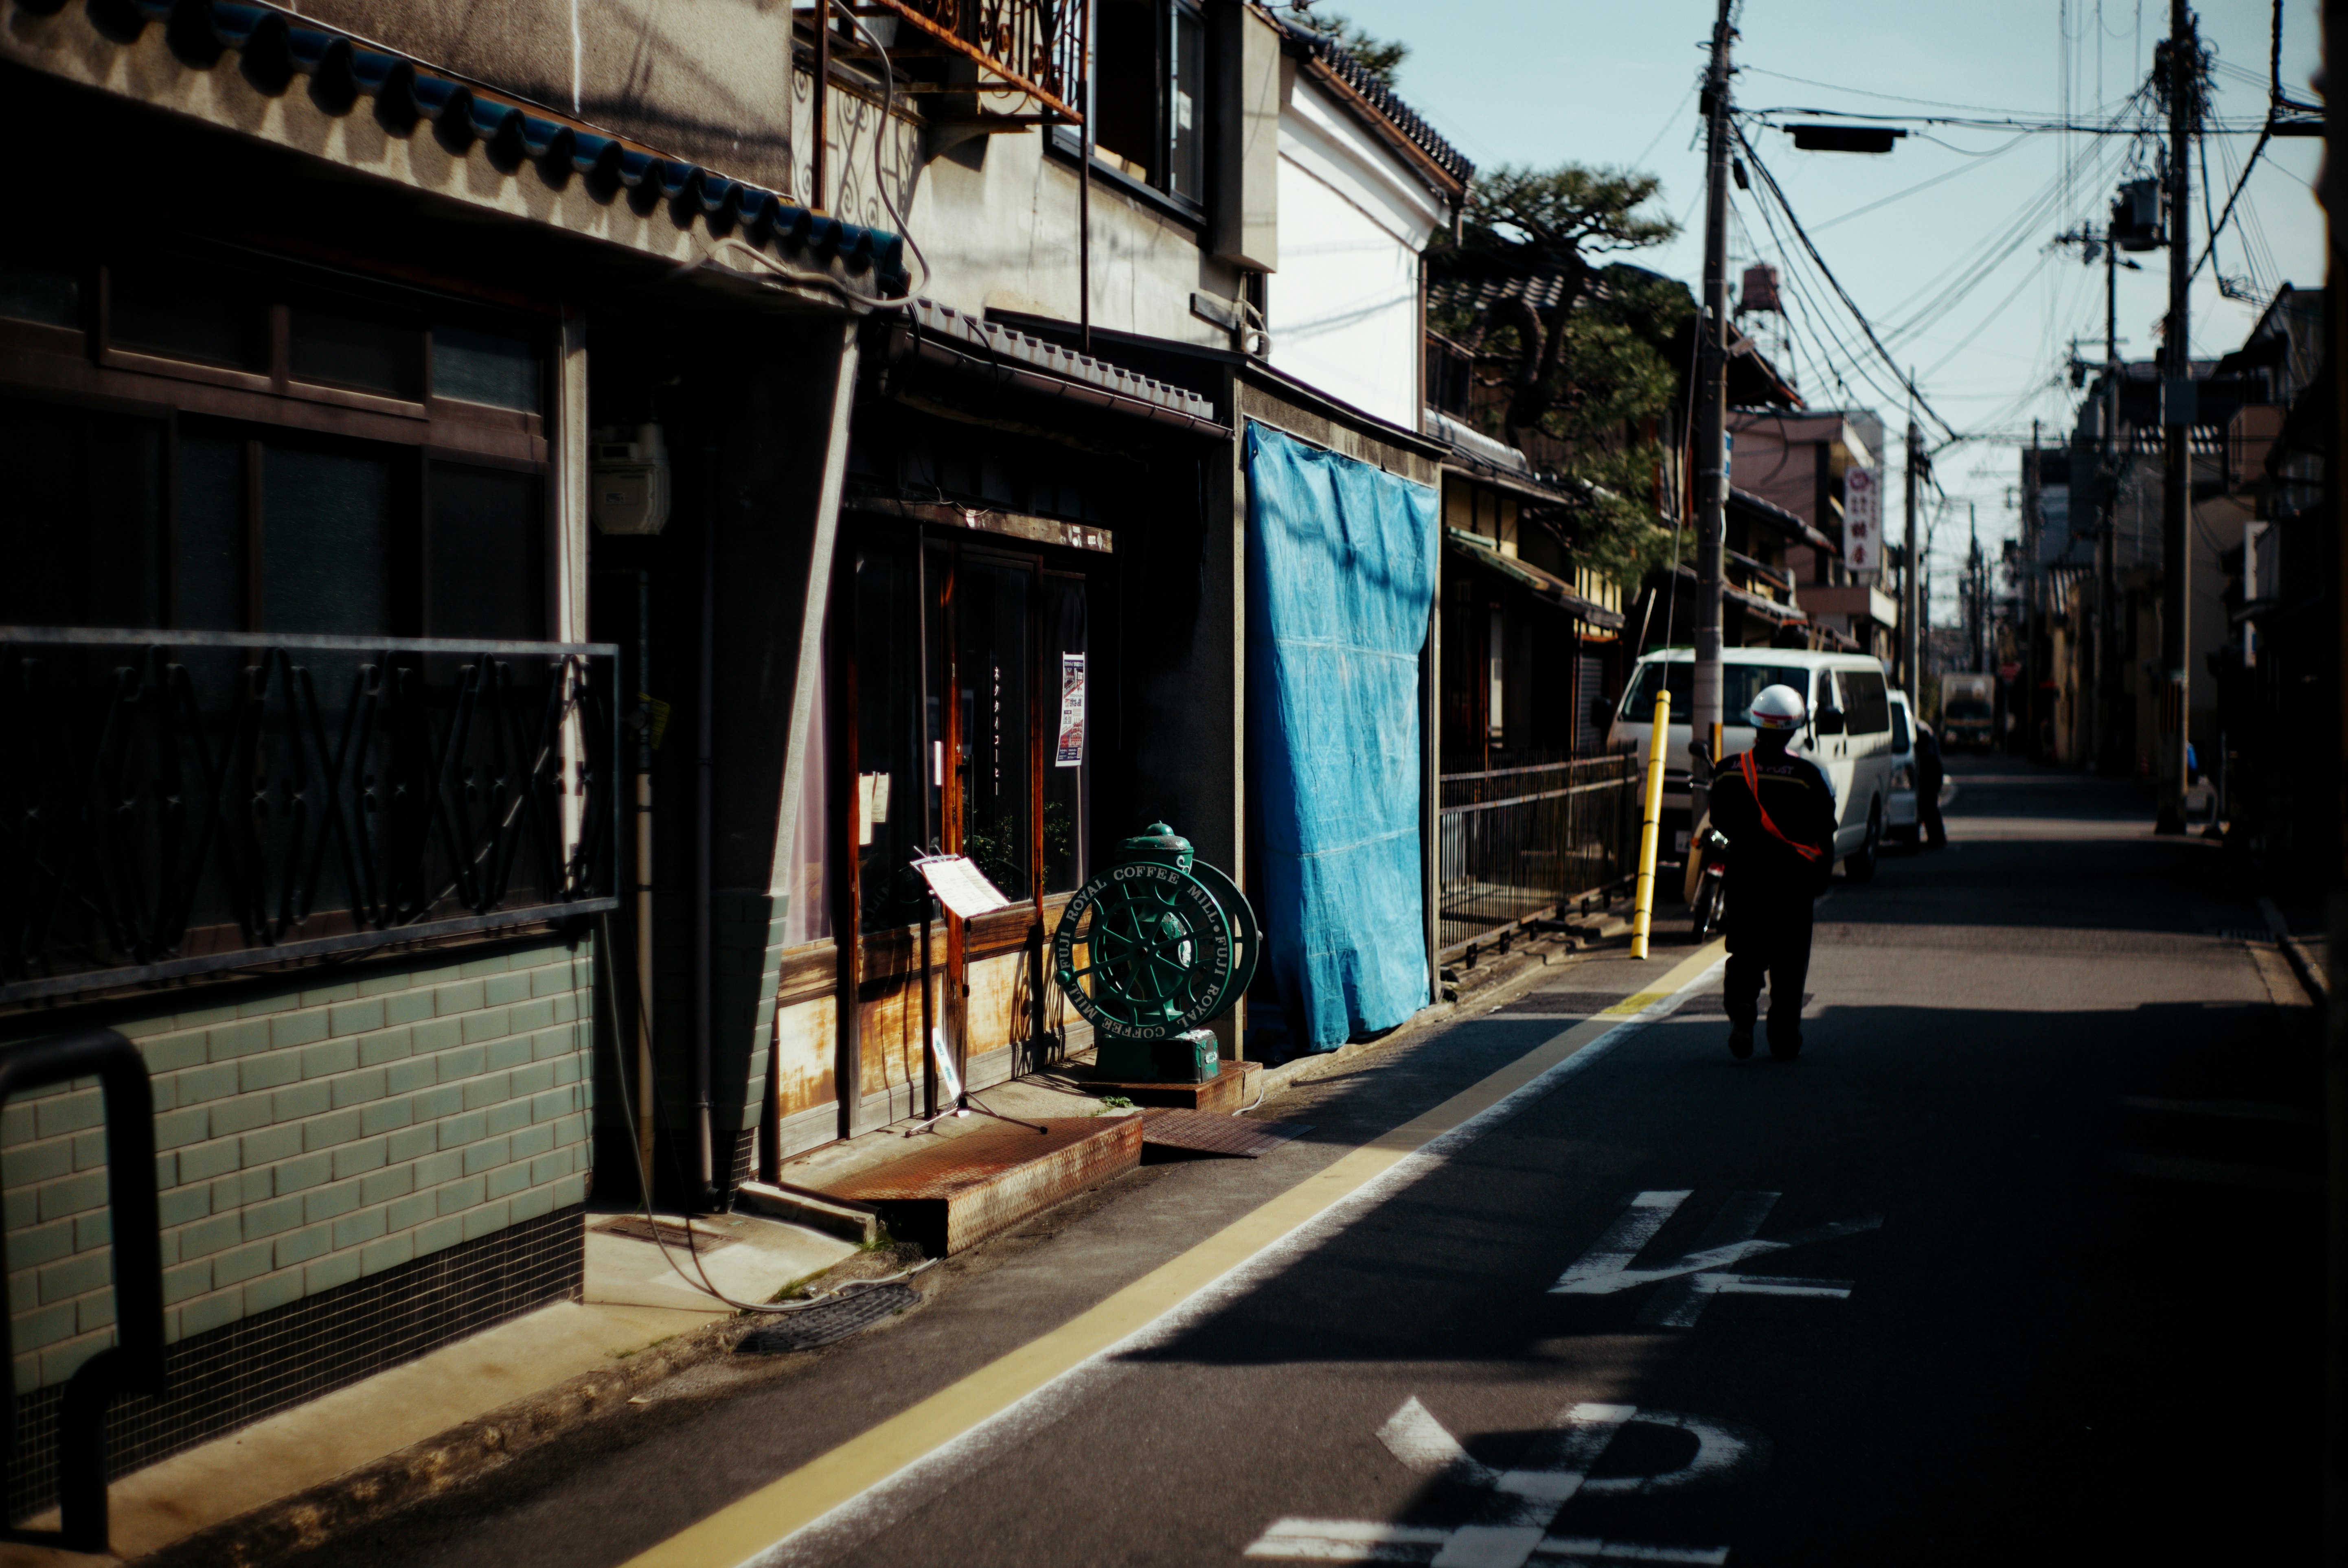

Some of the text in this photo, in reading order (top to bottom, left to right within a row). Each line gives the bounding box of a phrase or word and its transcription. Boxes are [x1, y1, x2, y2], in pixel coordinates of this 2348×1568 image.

[1731, 760, 1763, 772] JAN
[1059, 866, 1217, 970] FUJI ROYAL COFFEE MILL
[1068, 935, 1227, 1039] FUJI ROYAL COFFEE MILL
